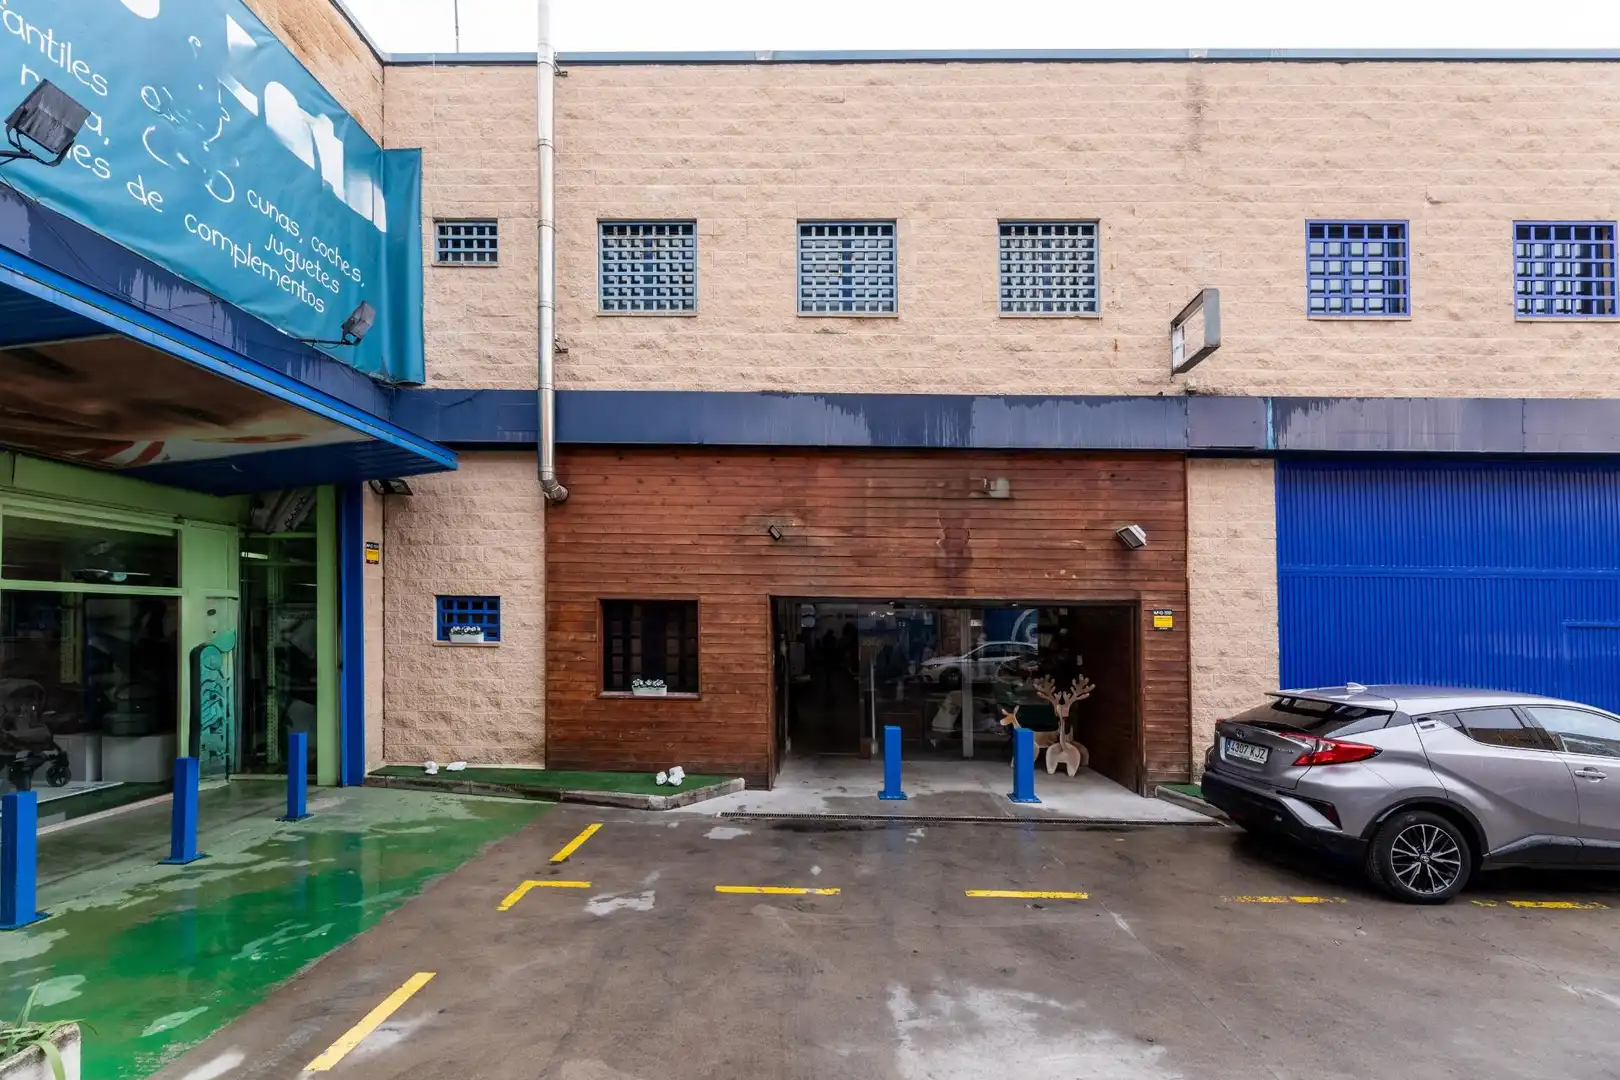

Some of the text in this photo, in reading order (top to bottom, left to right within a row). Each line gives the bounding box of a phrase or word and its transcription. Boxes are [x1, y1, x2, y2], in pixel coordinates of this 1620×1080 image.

[127, 174, 164, 213] de
[184, 213, 325, 313] complementos
[247, 189, 365, 288] cunas, coches,
[264, 233, 340, 294] juguetes
